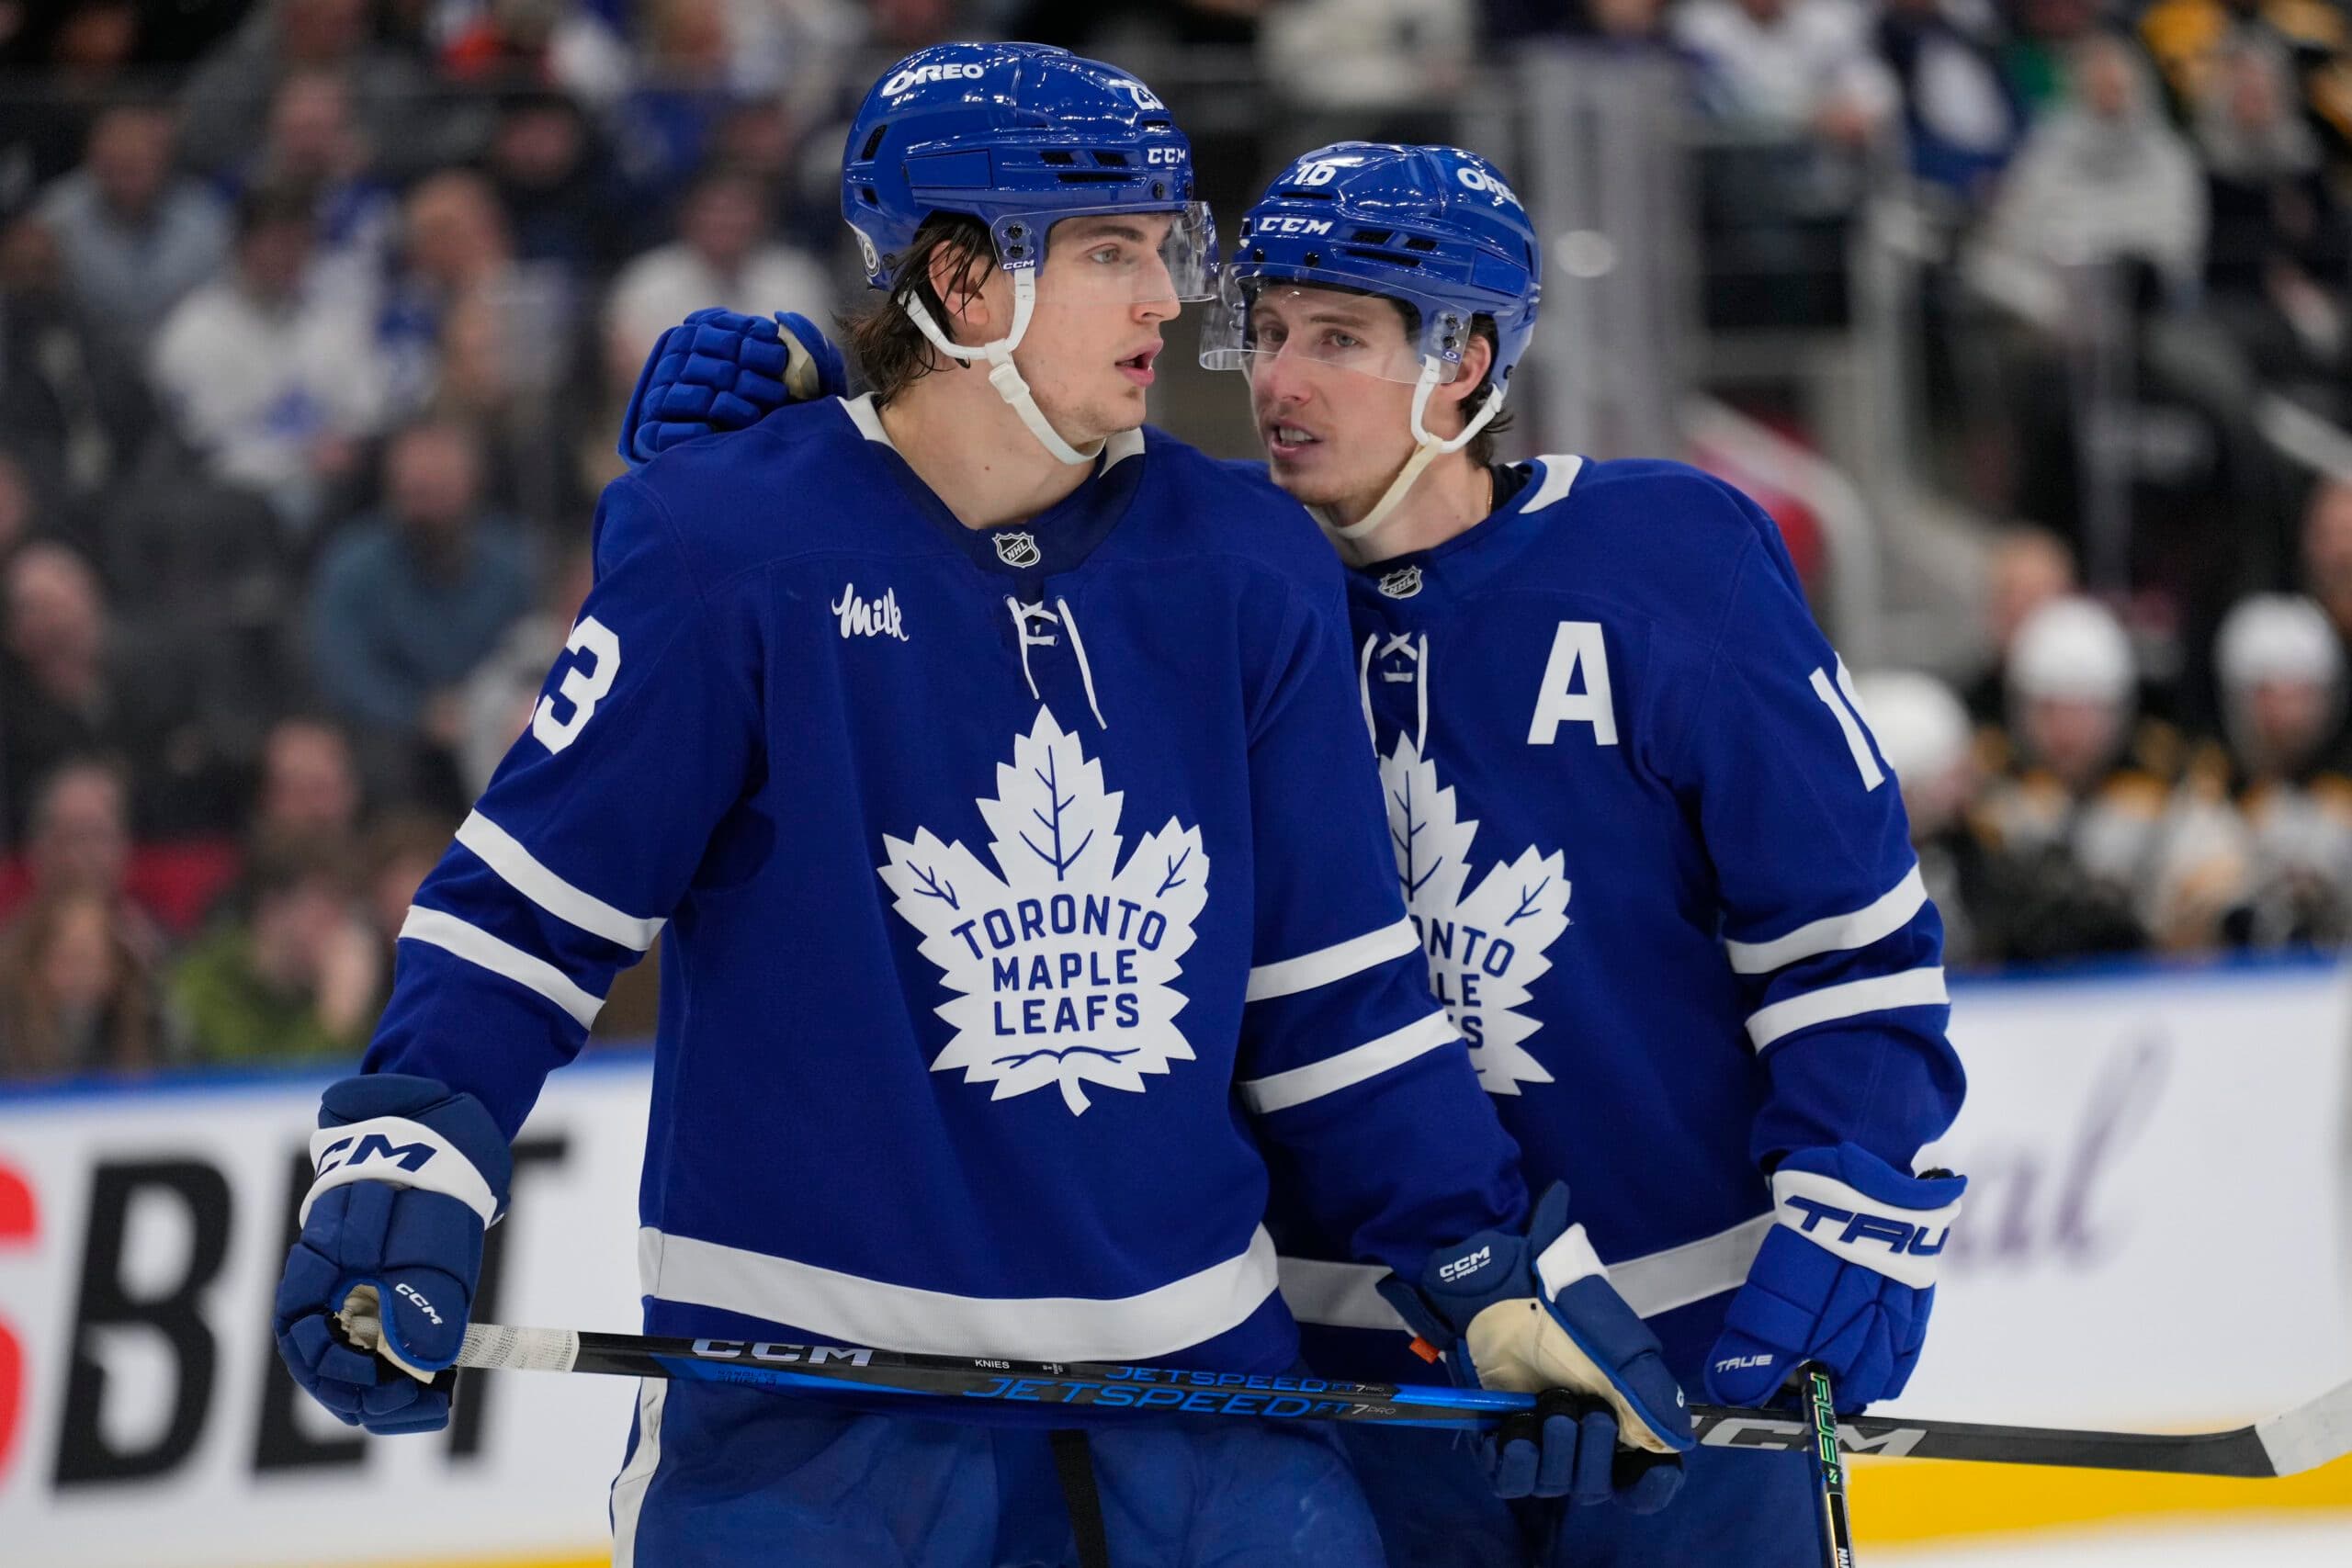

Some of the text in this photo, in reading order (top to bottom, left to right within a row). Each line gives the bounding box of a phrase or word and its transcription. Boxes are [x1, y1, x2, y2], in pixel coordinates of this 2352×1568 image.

[881, 63, 985, 97] OREO
[1147, 147, 1187, 164] CCM
[1293, 164, 1337, 186] 16
[1258, 217, 1334, 236] CCM
[1002, 260, 1035, 271] CCM
[1006, 542, 1028, 560] NHL
[831, 582, 910, 642] Milk
[528, 616, 621, 755] 3
[1527, 620, 1619, 746] A
[950, 894, 1167, 960] TORONTO
[992, 949, 1138, 992] MAPLE
[993, 993, 1140, 1036] LEAFS
[1438, 1245, 1491, 1279] CCM
[1455, 1264, 1478, 1280] PRO
[394, 1282, 443, 1325] CCM
[691, 1337, 874, 1368] CCM
[975, 1359, 1011, 1370] KNIES
[1714, 1354, 1774, 1373] TRUE
[1105, 1366, 1326, 1393] JETSPEED
[962, 1377, 1312, 1417] JETSPEED
[1690, 1415, 1927, 1458] CM
